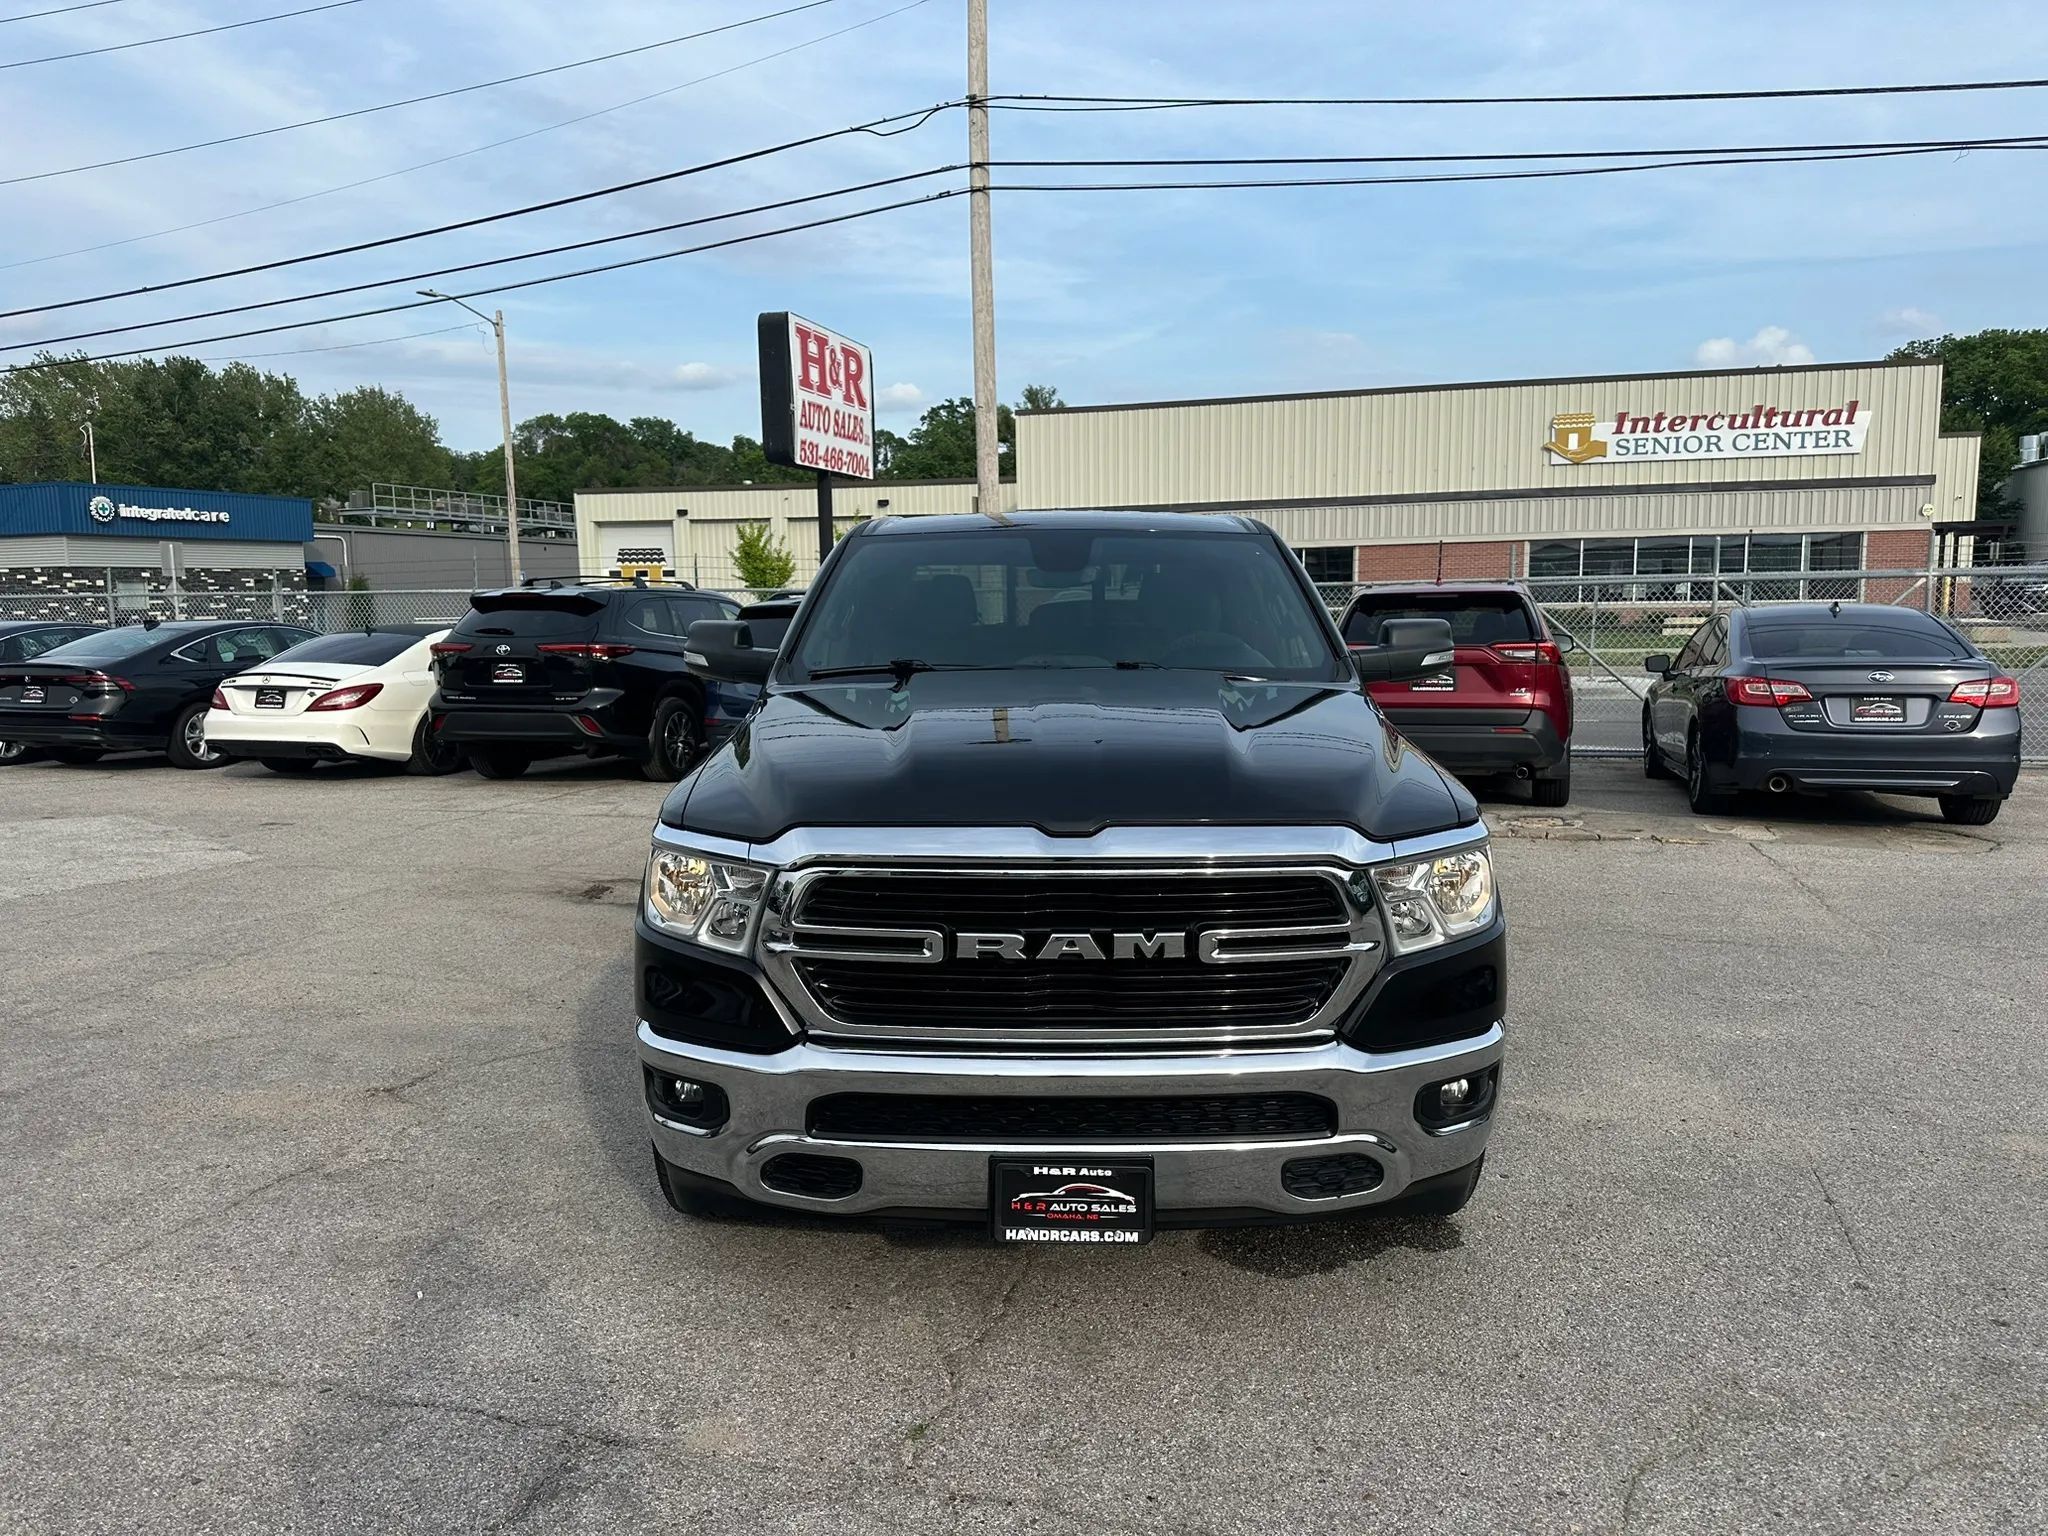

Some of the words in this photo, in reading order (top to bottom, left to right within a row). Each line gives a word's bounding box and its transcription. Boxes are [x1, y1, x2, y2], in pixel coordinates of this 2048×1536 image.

[795, 323, 868, 412] H&R
[800, 399, 831, 433] AUTO
[833, 409, 864, 446] SALES
[1611, 399, 1860, 435] Intercultural
[1615, 433, 1722, 456] SENIOR
[1732, 429, 1853, 452] CENTER
[799, 438, 870, 477] 531-466-7004
[118, 503, 230, 522] integratedcare
[956, 931, 1185, 962] RAM
[1033, 1166, 1076, 1176] H&R
[1079, 1167, 1112, 1177] Auto
[1011, 1202, 1021, 1210] H
[1024, 1202, 1033, 1210] &
[1036, 1202, 1046, 1210] R
[1049, 1203, 1088, 1212] AUTO
[1091, 1203, 1137, 1213] SALES
[1006, 1228, 1139, 1243] HANDRCARS.COM
